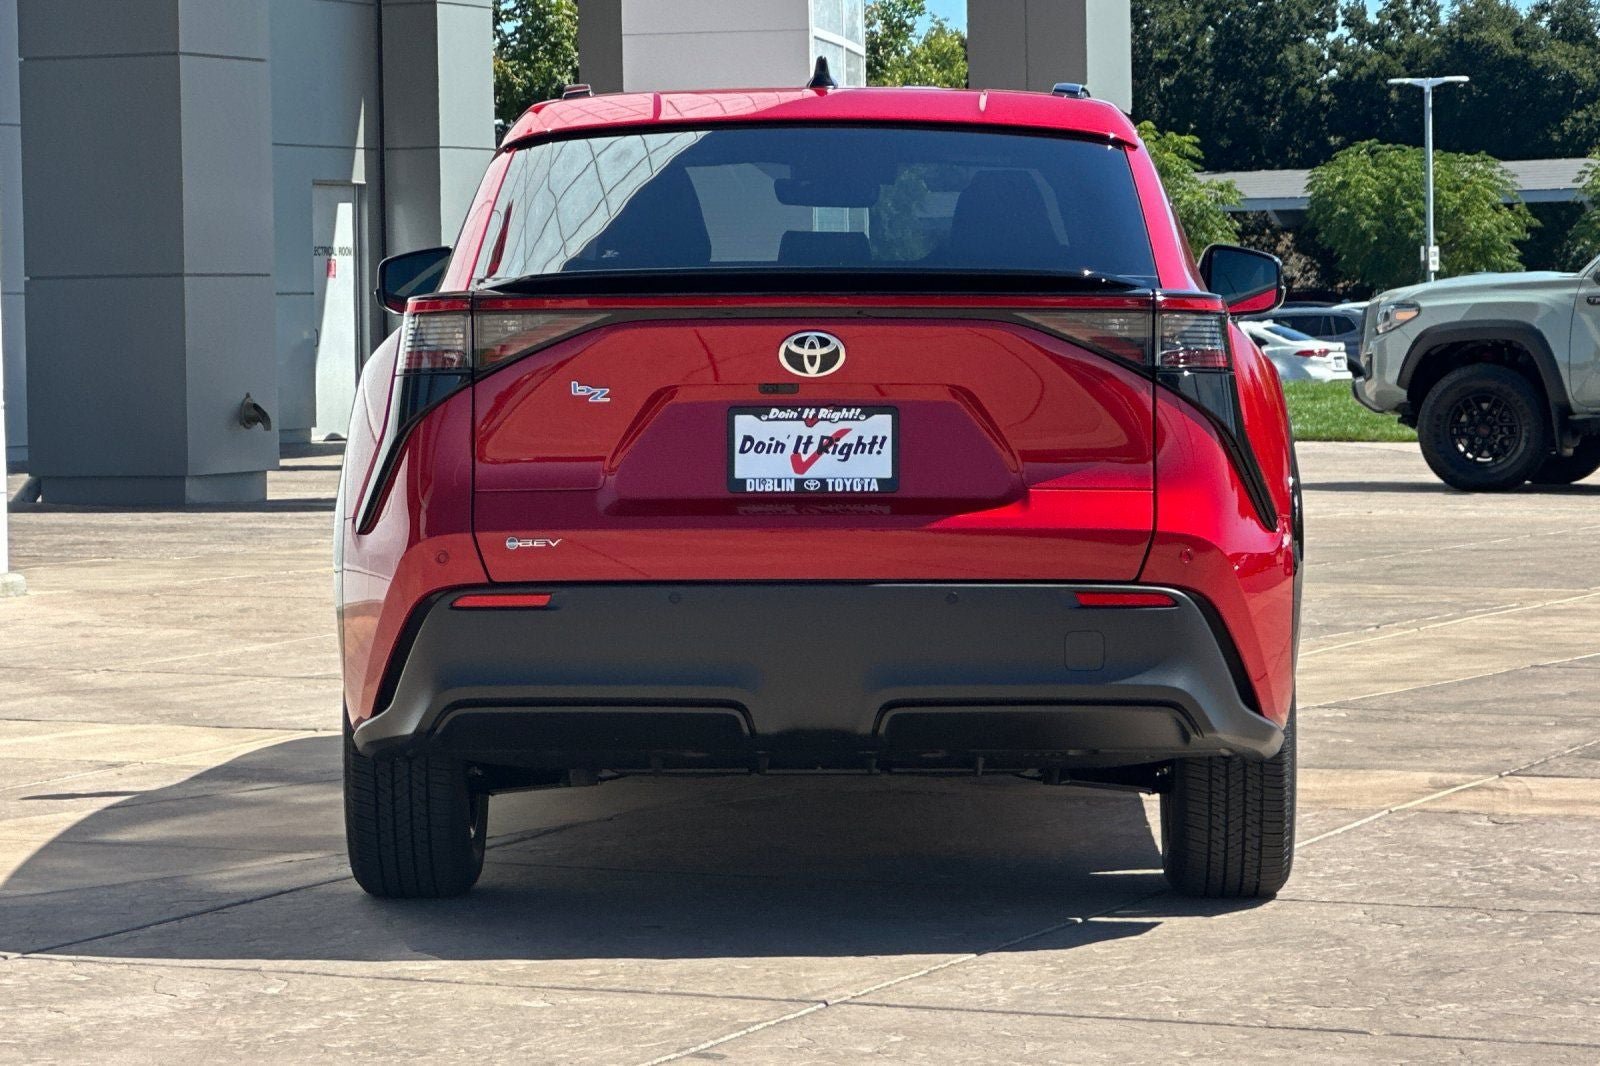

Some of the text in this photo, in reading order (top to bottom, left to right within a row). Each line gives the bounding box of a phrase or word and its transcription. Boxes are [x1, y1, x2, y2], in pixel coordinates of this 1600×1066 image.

[768, 407, 862, 423] Doin' It Right!
[738, 434, 888, 463] Doin' It Right!
[745, 478, 879, 492] DUBLIN TOYOTA
